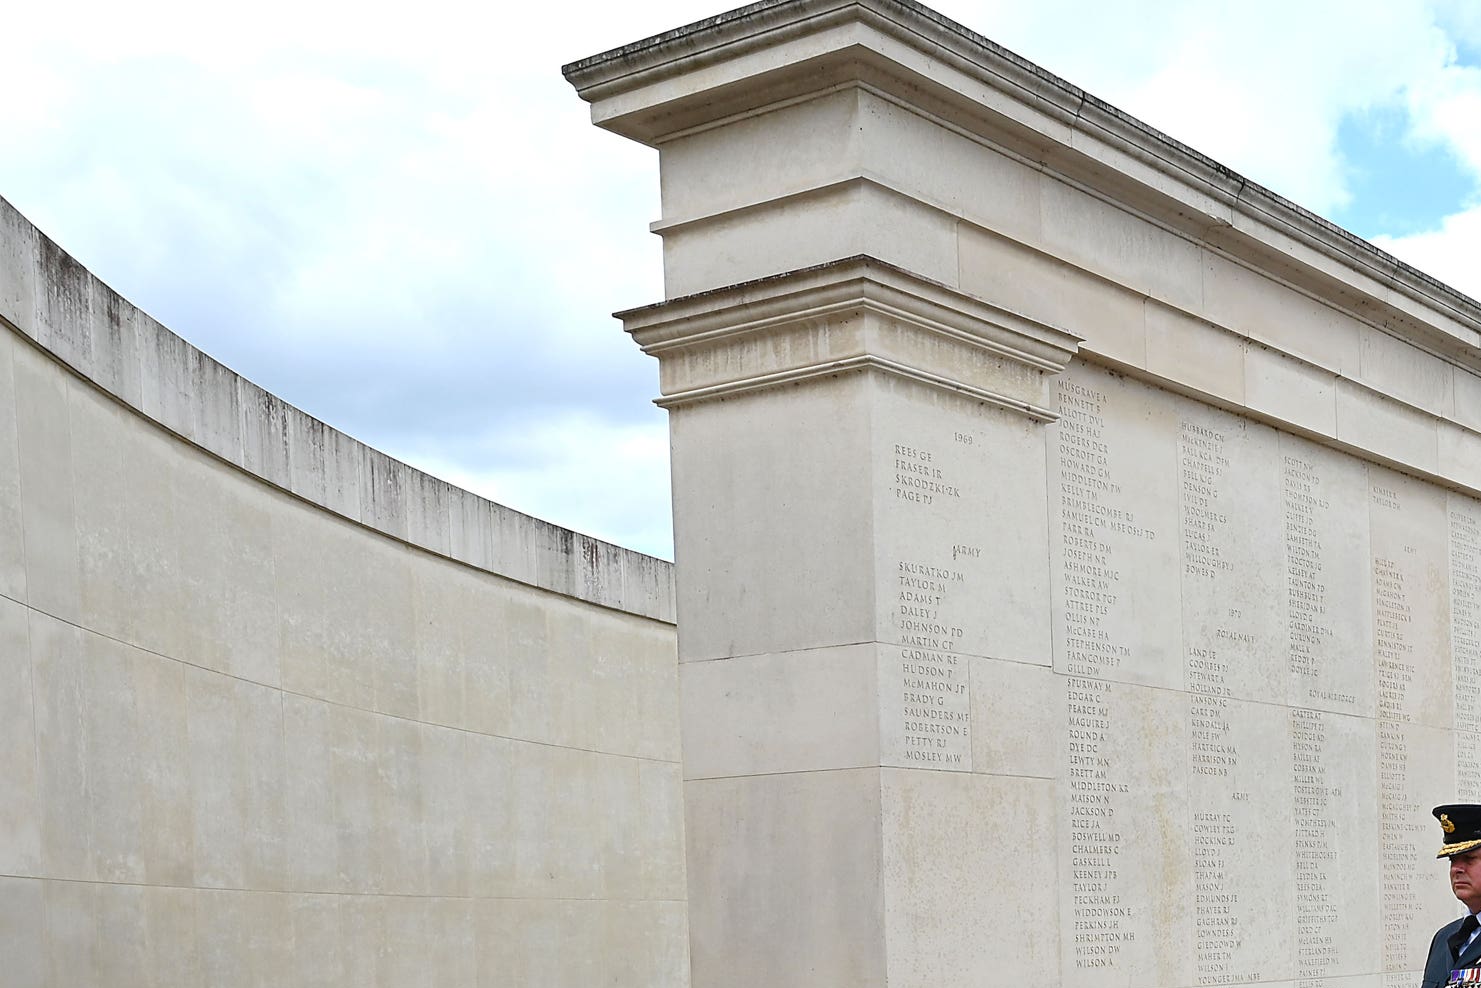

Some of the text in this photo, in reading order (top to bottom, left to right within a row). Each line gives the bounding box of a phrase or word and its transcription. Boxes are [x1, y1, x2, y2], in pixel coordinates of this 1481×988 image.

[1058, 379, 1099, 401] MUSGRAVE
[1058, 405, 1086, 422] ALLOTT
[1058, 418, 1083, 434] JONES
[954, 432, 972, 445] 1969
[1059, 430, 1089, 448] ROGERS
[894, 444, 916, 458] REES
[1059, 443, 1094, 462] OSCROFT
[895, 459, 928, 475] FRASER
[1060, 457, 1095, 475] HOWARD
[1061, 469, 1108, 491] MIDDLETON
[896, 488, 920, 502] PAGE
[1061, 482, 1083, 496] KELLY
[1061, 495, 1121, 519] BRIMBLECOMBE
[1062, 508, 1092, 524] SAMUEL
[1062, 521, 1082, 534] PARR
[1063, 534, 1096, 550] ROBERTS
[954, 544, 980, 557] ARMY
[1063, 547, 1092, 562] JOSEPH
[898, 561, 949, 579] SKURATKO
[1063, 560, 1101, 576] ASHMORE
[898, 575, 934, 590] TAYLOR
[1064, 573, 1095, 587] WALKER
[899, 590, 932, 604] ADAMS
[900, 605, 929, 618] DALEY
[1065, 598, 1092, 612] ATTREE
[1065, 611, 1086, 624] OLLIS
[900, 619, 947, 635] JOHNSON
[1066, 624, 1095, 638] McCABE
[901, 634, 938, 647] MARTIN
[1066, 637, 1117, 654] STEPHENSON
[901, 649, 943, 663] CADMAN
[1067, 650, 1113, 665] FARNCOMBE
[902, 664, 944, 677] HUDSON
[1067, 663, 1084, 674] GILL
[902, 678, 952, 692] McMAHON
[1067, 678, 1102, 691] SPURWAY
[903, 692, 934, 704] BRADY
[1067, 691, 1094, 702] EDGAR
[903, 707, 954, 720] SAUNDERS
[1068, 704, 1095, 715] PEARCE
[904, 722, 959, 735] ROBERTSON
[1068, 716, 1103, 728] MAGUIRE
[905, 736, 932, 746] PETTY
[1068, 729, 1097, 740] ROUND
[905, 750, 942, 761] MOSLEY
[1070, 768, 1093, 778] BRETT
[1070, 780, 1116, 792] MIDDLETON
[1070, 793, 1101, 803] MAISON
[1070, 806, 1105, 816] JACKSON
[1071, 819, 1088, 828] RICE
[1072, 832, 1105, 841] BOSWELL
[1072, 844, 1112, 854] CHALMERS
[1072, 857, 1104, 866] GASKELL
[1073, 870, 1101, 878] KEENEY
[1073, 883, 1102, 891] TAYLOR
[1074, 895, 1110, 904] PECKHAM
[1074, 908, 1125, 916] WIDDOWSON
[1074, 920, 1106, 929] PERKINS
[1075, 932, 1120, 942] SHRIMPTON
[1075, 946, 1105, 955] WILSON
[1075, 958, 1105, 968] WILSON
